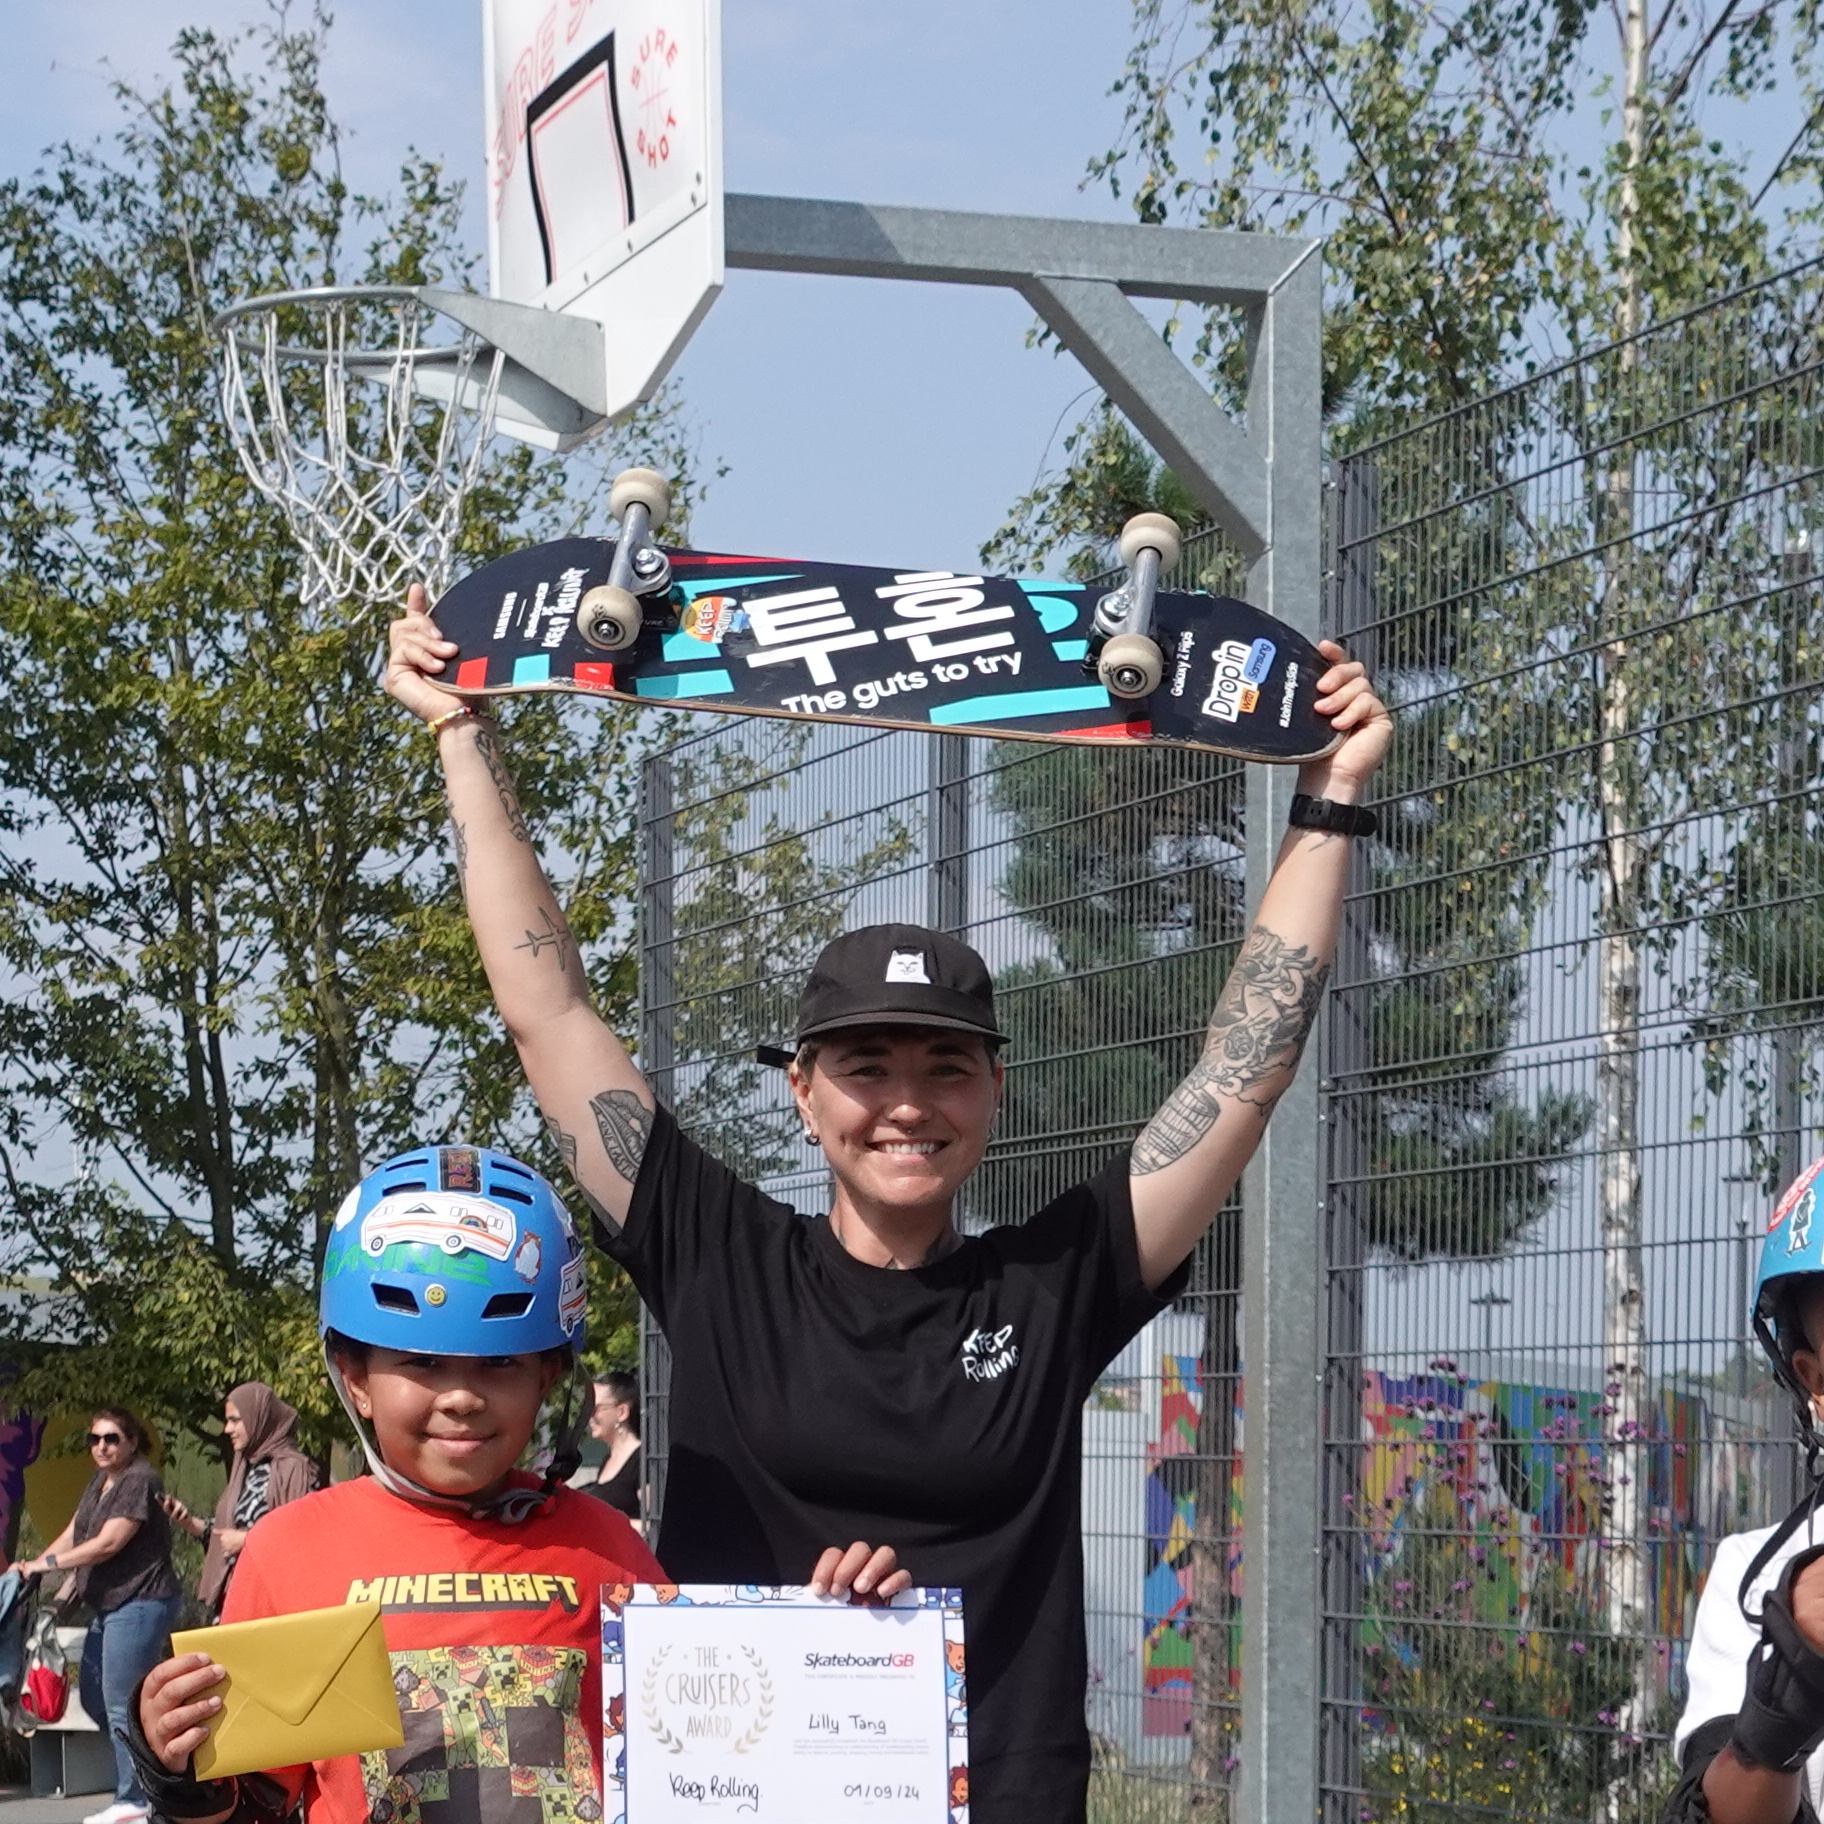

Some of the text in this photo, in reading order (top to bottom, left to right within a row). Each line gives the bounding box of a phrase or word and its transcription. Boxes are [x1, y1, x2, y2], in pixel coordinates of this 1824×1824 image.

[630, 27, 678, 90] SURE
[636, 108, 677, 170] SHOT
[492, 591, 517, 640] SAMSUNG
[541, 616, 572, 648] KEEP
[694, 601, 714, 635] KEEP
[742, 571, 1015, 686] 투혼
[781, 651, 1022, 714] The guts to try
[1208, 644, 1253, 720] Drop in
[1241, 643, 1272, 710] with Samsung
[345, 1573, 580, 1611] MINECRAFT
[695, 1646, 719, 1668] THE
[803, 1652, 915, 1670] SkateboardGB
[665, 1672, 751, 1711] CRUISERS
[686, 1714, 733, 1739] AWARD
[809, 1713, 887, 1736] Lilly Tang
